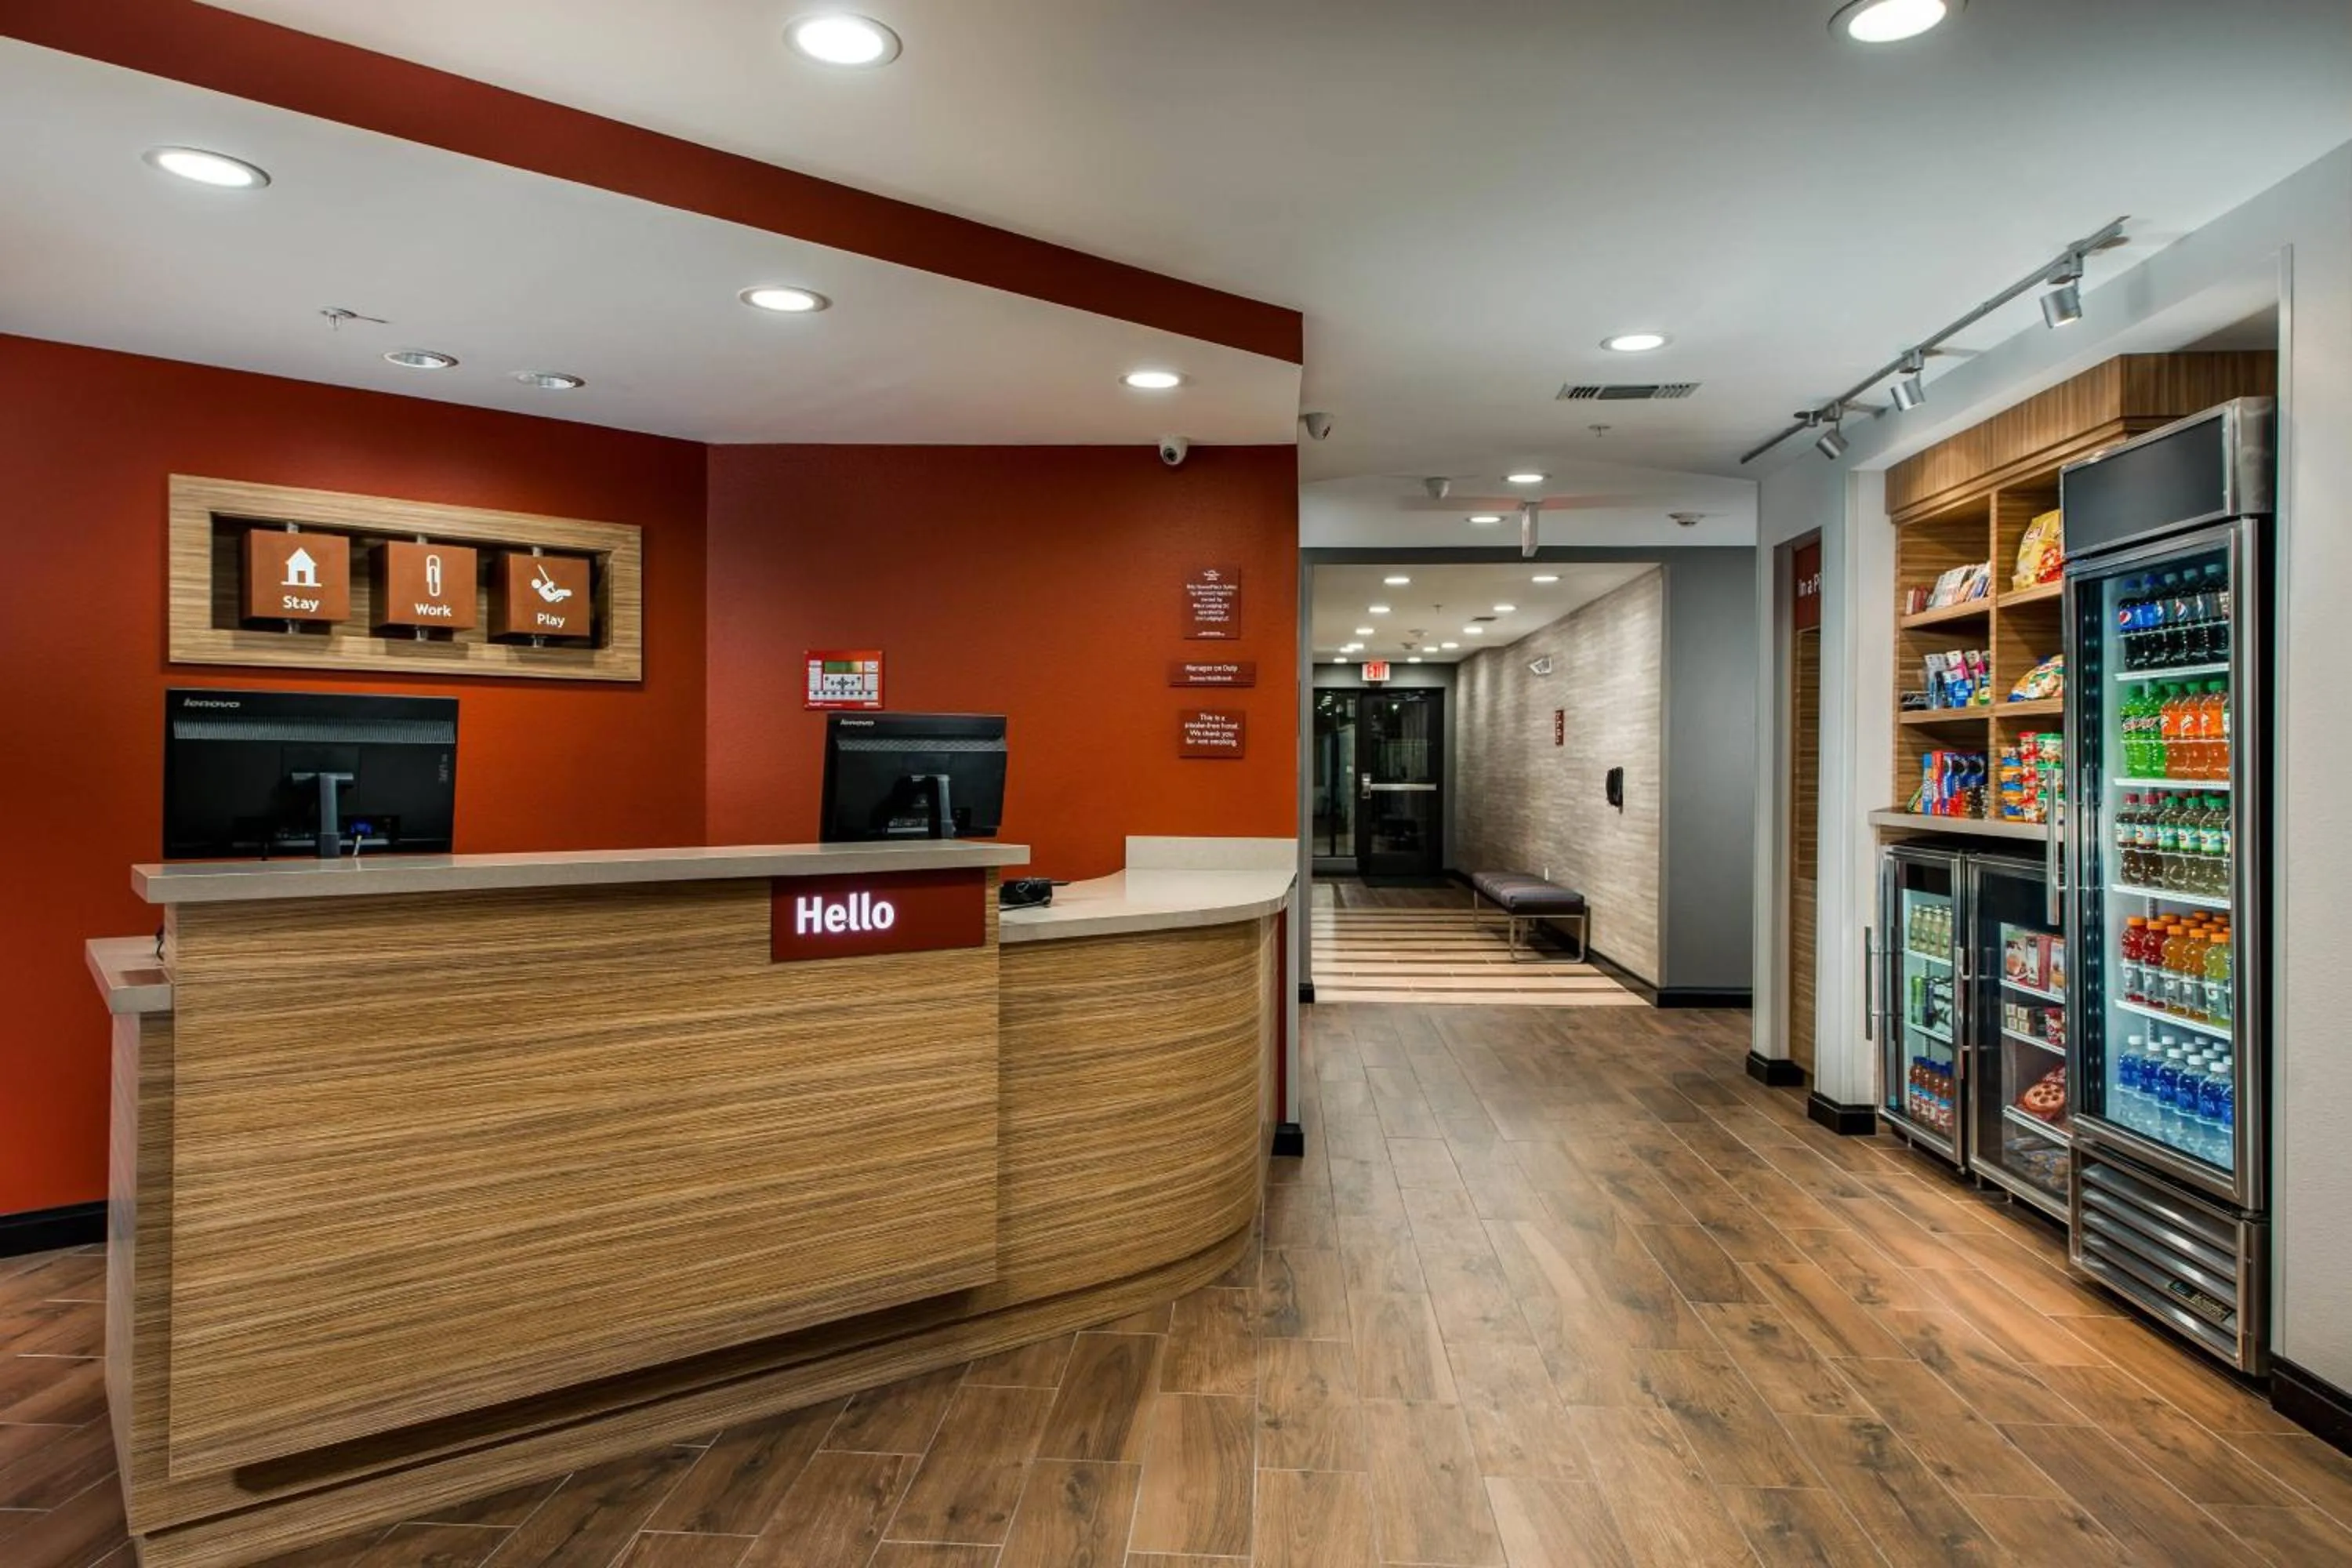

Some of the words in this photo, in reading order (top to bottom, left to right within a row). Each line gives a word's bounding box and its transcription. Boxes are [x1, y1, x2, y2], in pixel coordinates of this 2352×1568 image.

[282, 595, 320, 612] Stay
[414, 603, 452, 617] Work
[536, 612, 565, 628] Play
[1367, 664, 1385, 678] EXIT
[183, 697, 241, 708] lenovo
[797, 891, 895, 935] Hello
